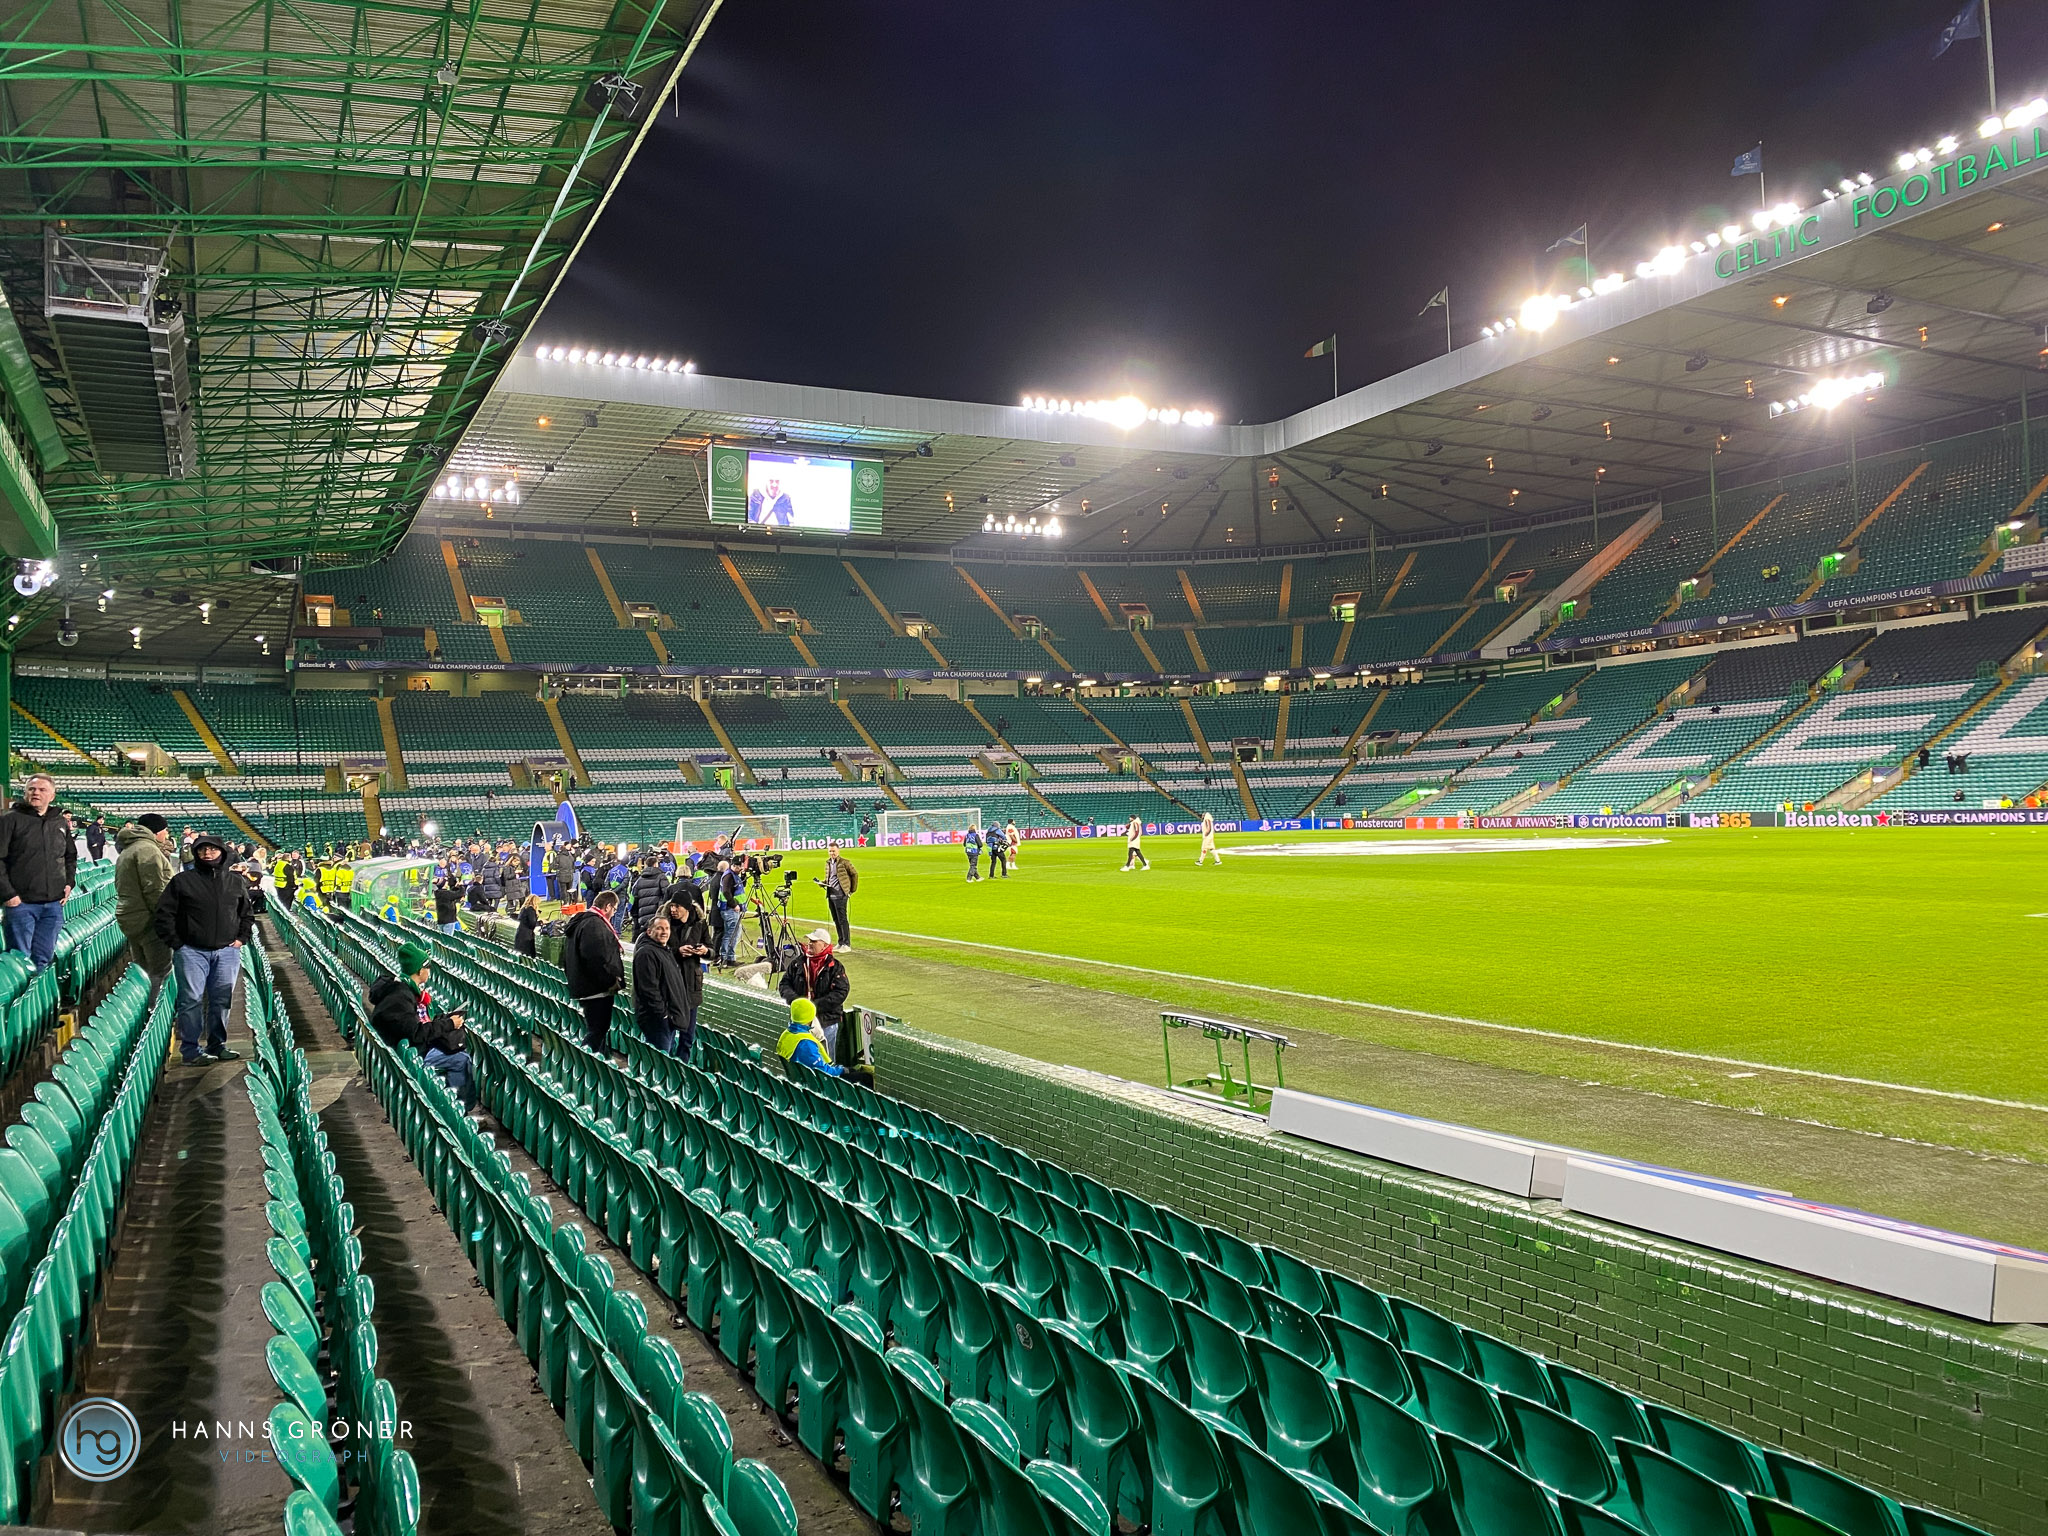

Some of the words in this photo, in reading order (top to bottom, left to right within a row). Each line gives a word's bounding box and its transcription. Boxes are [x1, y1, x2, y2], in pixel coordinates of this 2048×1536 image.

[1714, 215, 1820, 279] CELTIC
[1852, 127, 2048, 228] FOOTBALL
[1828, 599, 1849, 609] UEFA
[1849, 591, 1898, 605] CHAMPIONS
[1899, 586, 1932, 598] LEAGUE
[1579, 636, 1595, 645] UEFA
[1595, 631, 1629, 642] CHAMPIONS
[1630, 627, 1653, 637] LEAGUE
[1375, 660, 1410, 669] CHAMPIONS
[1411, 657, 1433, 665] LEAGUE
[1272, 820, 1302, 829] PS5
[1355, 819, 1403, 828] mastercard
[1481, 817, 1513, 828] QATAR
[1515, 817, 1556, 828] AIRWAYS
[1592, 814, 1662, 828] crypto.com
[1689, 813, 1752, 828] bet365
[1784, 811, 1874, 827] Heineken
[1921, 813, 1951, 824] UEFA
[1953, 812, 2026, 823] CHAMPIONS
[1029, 828, 1073, 839] AIRWAYS
[1096, 824, 1128, 837] PEP
[1176, 822, 1236, 834] crypcom
[781, 836, 854, 850] Heineken
